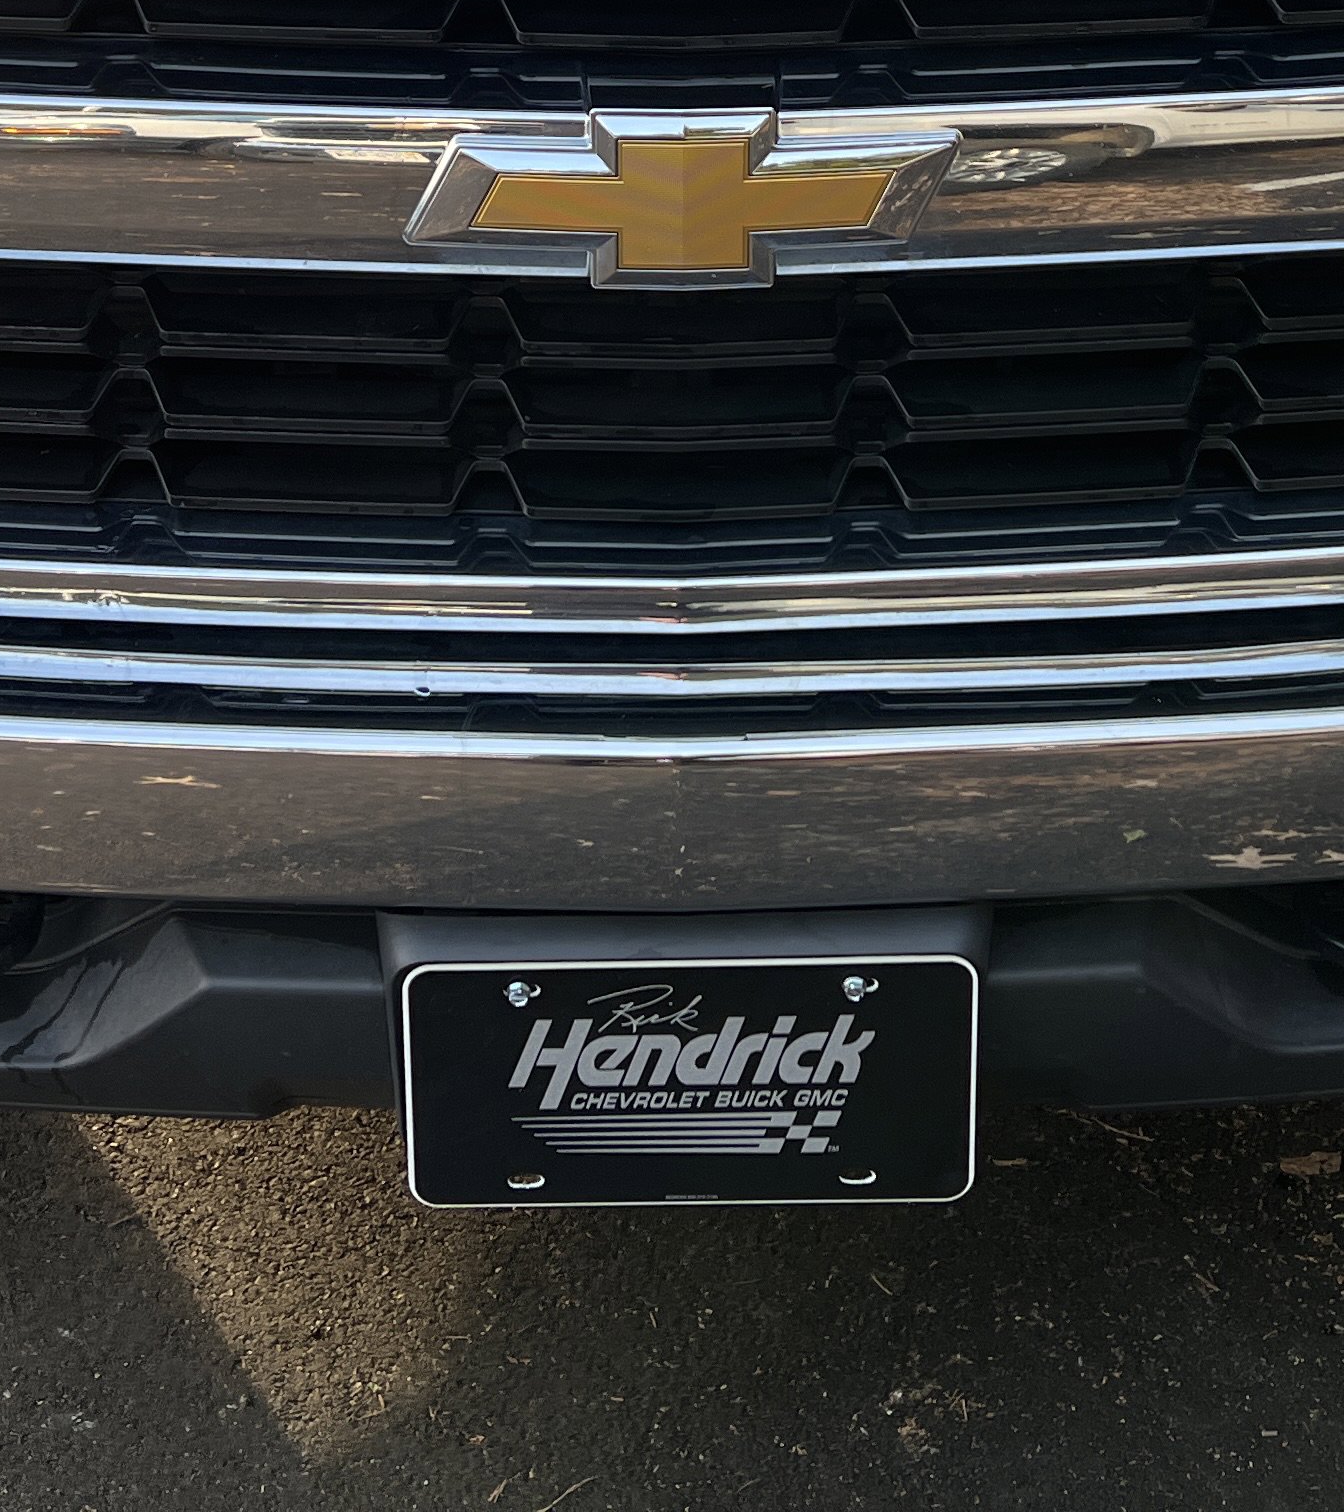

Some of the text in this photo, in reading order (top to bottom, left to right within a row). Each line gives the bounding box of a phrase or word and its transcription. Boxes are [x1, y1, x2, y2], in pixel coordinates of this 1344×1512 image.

[508, 1014, 876, 1110] Hendrick
[570, 1089, 849, 1110] CHEVROLET BUICK GMC
